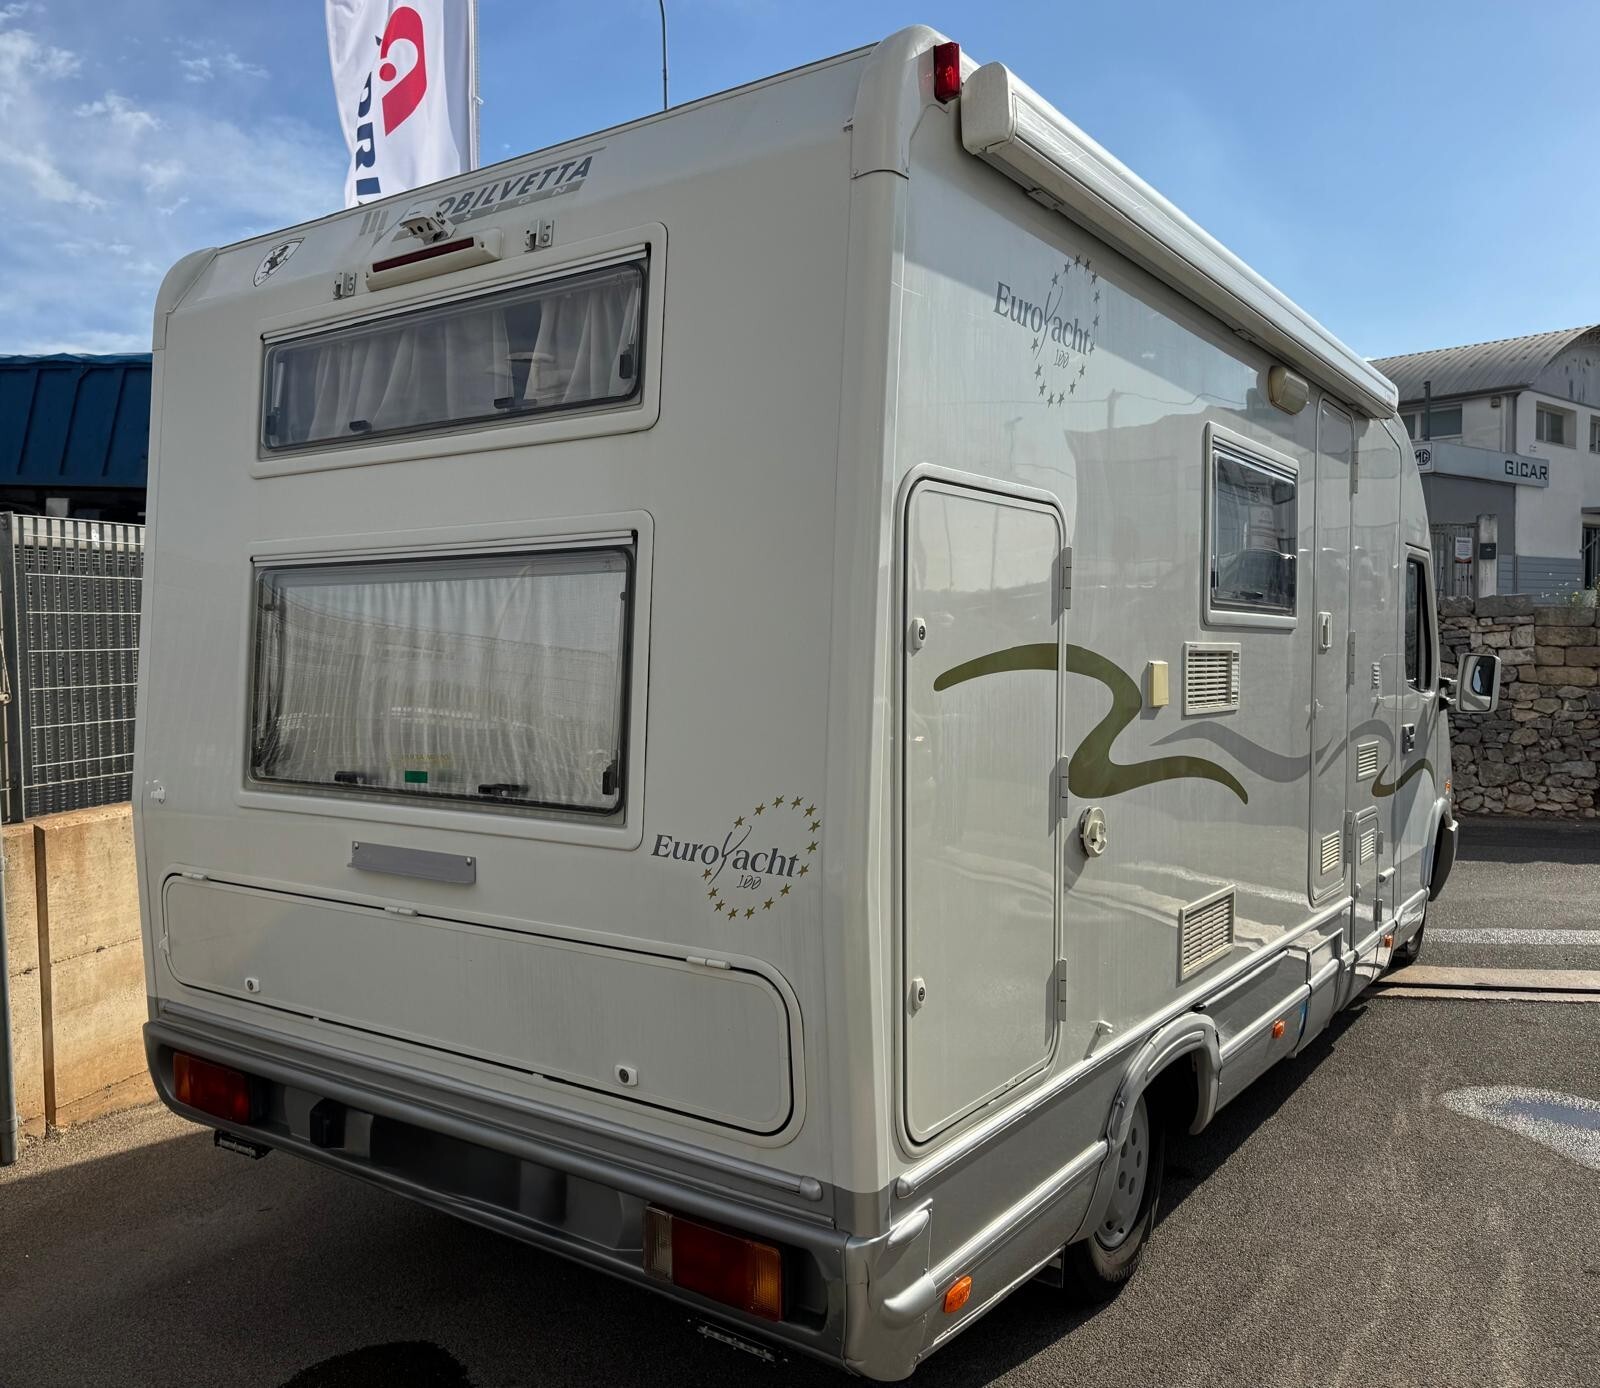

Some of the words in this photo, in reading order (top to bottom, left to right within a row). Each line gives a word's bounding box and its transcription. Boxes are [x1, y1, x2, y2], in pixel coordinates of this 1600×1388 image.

[437, 155, 593, 216] OBILVETTA
[993, 281, 1091, 360] EuroYacht
[651, 825, 799, 885] EuroYacht
